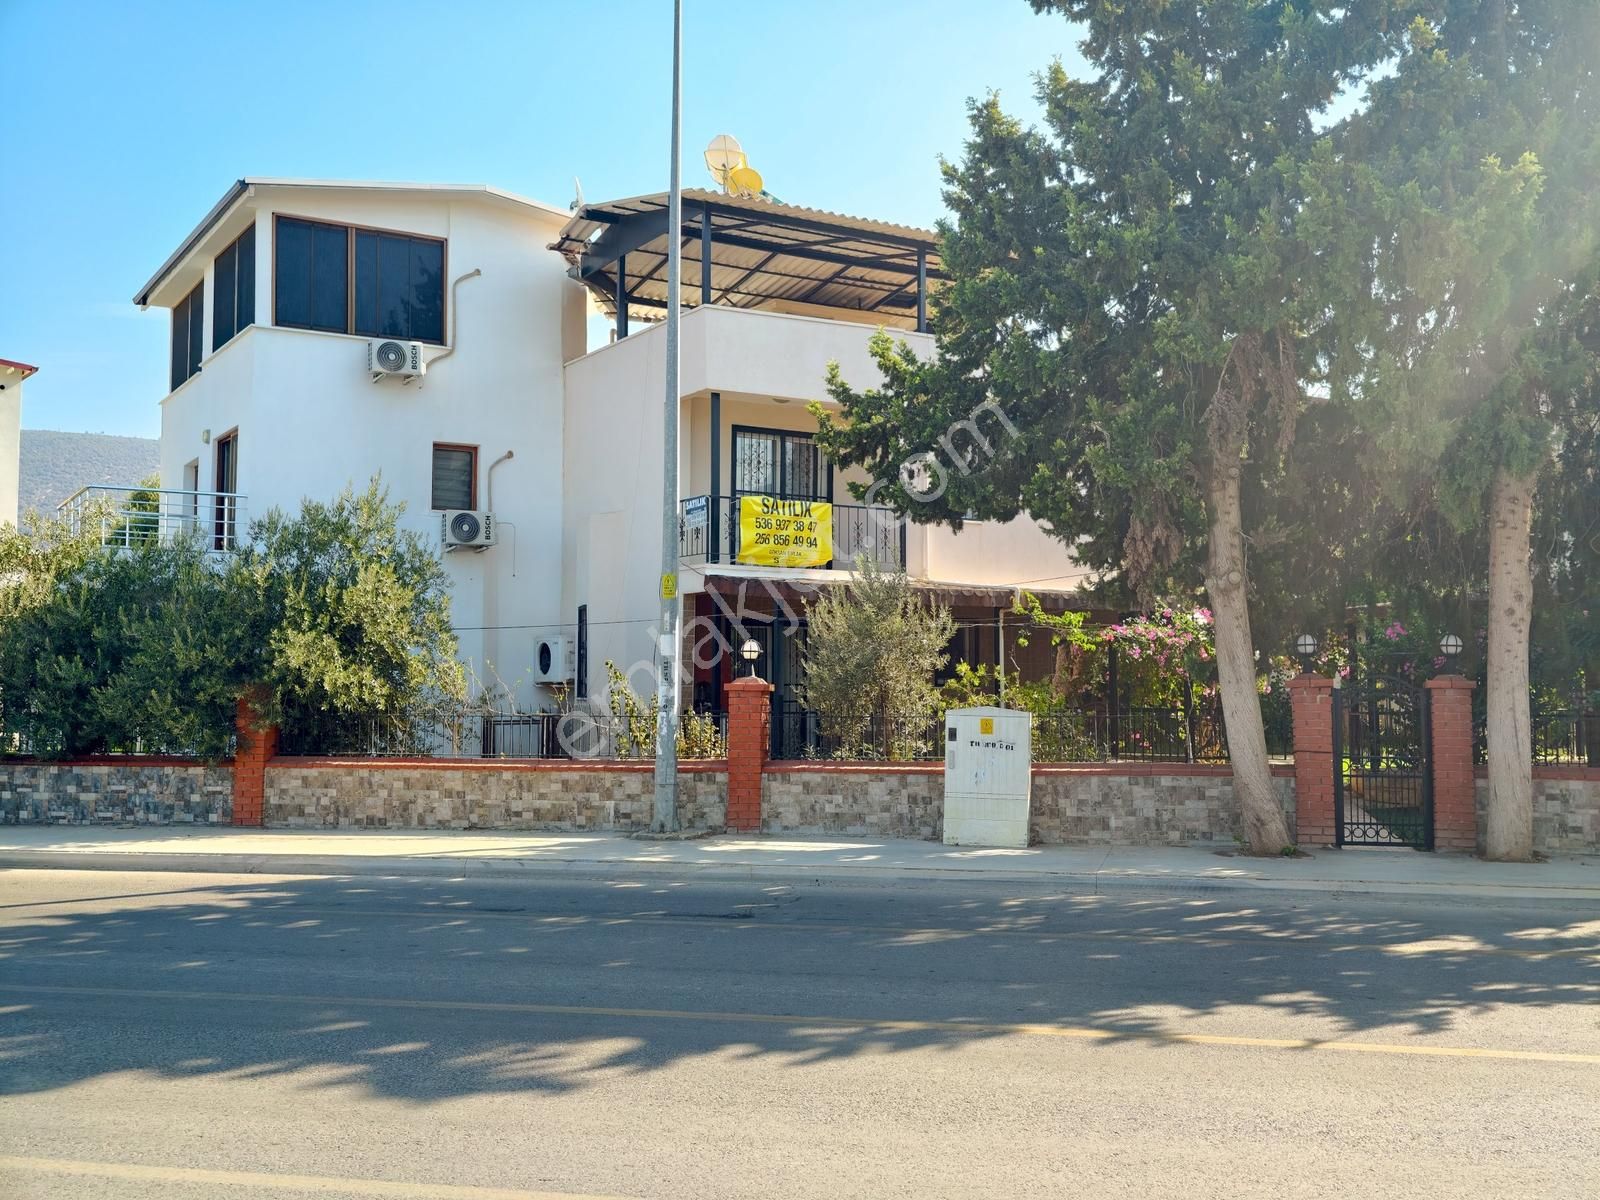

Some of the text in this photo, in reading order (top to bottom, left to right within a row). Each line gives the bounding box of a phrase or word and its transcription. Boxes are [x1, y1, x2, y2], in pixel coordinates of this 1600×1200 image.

[761, 497, 812, 518] SATILIK
[755, 517, 817, 533] 536 937 38 47
[755, 532, 818, 548] 256 856 49 94
